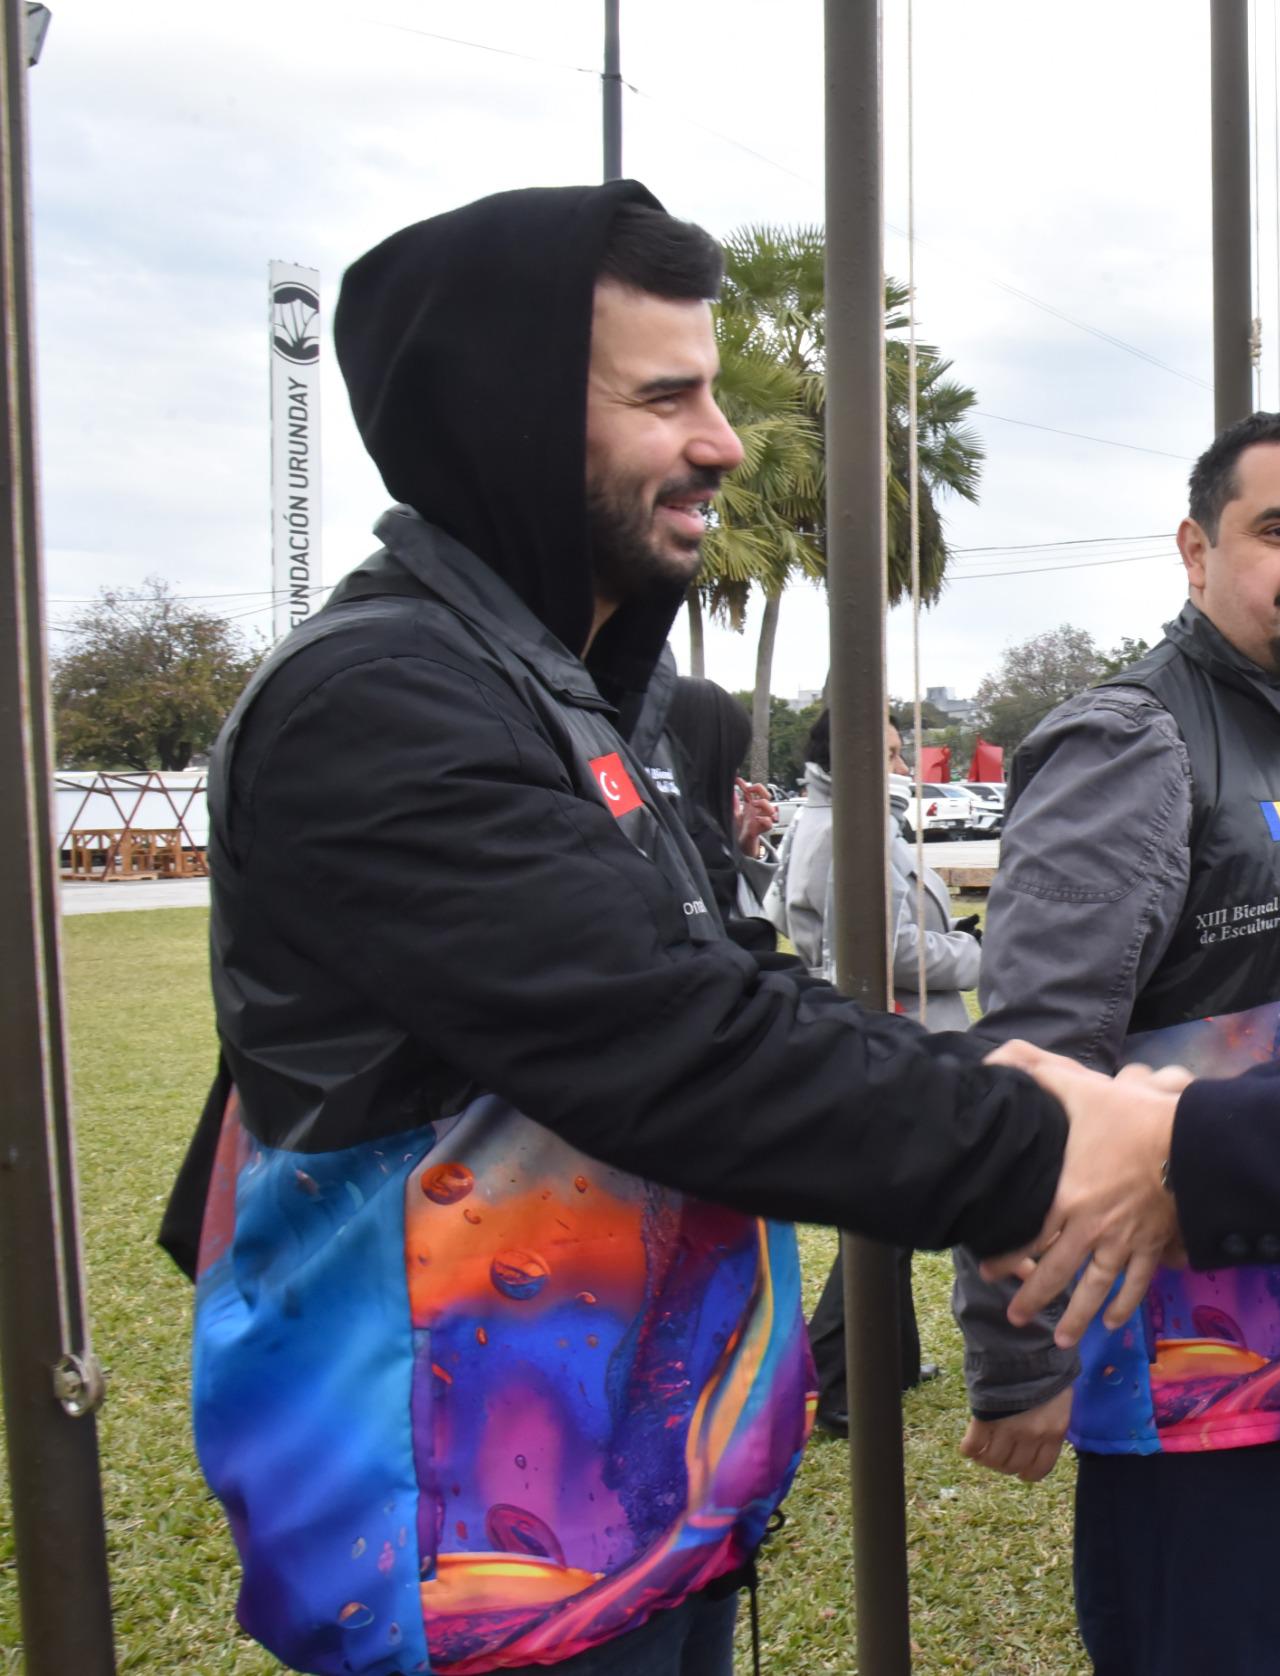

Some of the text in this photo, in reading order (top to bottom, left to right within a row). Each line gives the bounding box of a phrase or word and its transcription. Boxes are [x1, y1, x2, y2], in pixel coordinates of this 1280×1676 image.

[288, 376, 309, 489] URUNDAY
[1196, 909, 1227, 930] XIII
[1233, 897, 1279, 921] Bienal
[1200, 931, 1217, 944] de
